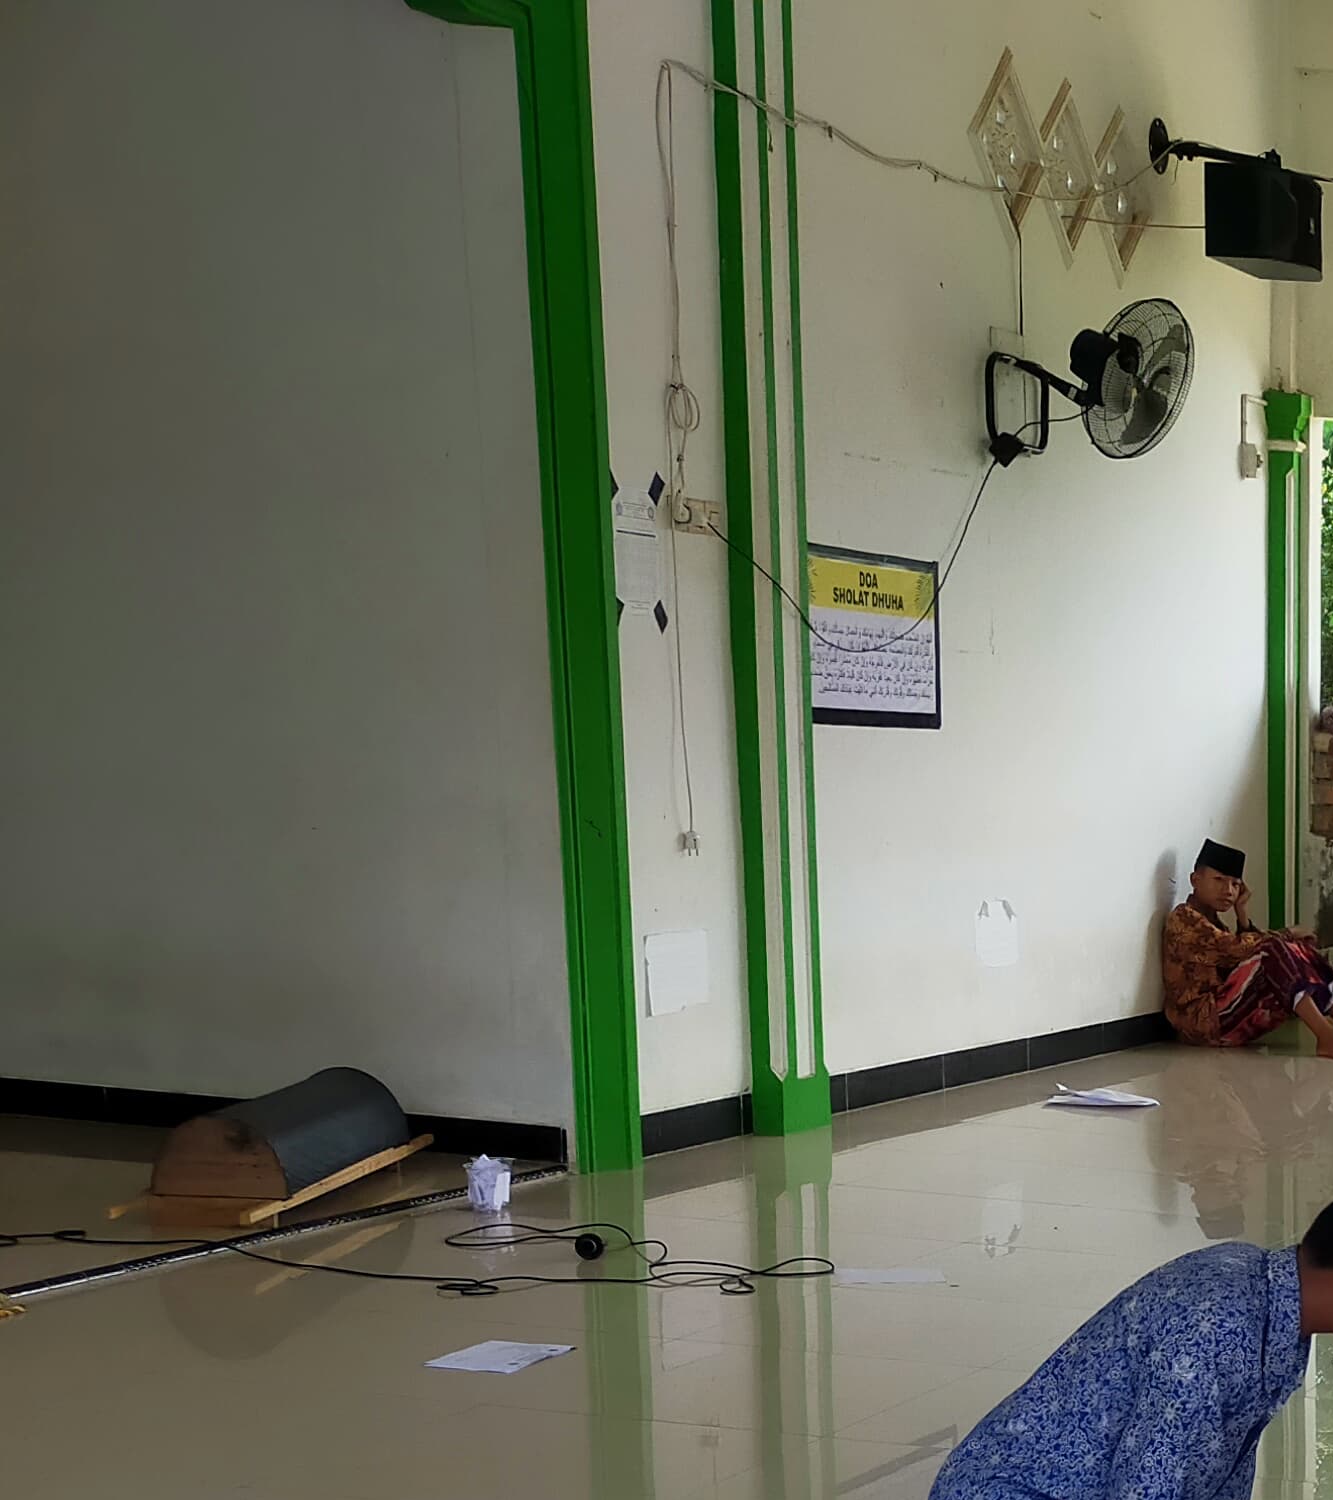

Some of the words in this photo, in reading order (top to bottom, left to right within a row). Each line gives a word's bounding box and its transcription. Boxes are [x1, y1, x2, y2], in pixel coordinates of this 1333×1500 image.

[859, 571, 878, 589] DOA
[833, 587, 869, 607] SHOLAT
[872, 591, 904, 611] DHUHA
